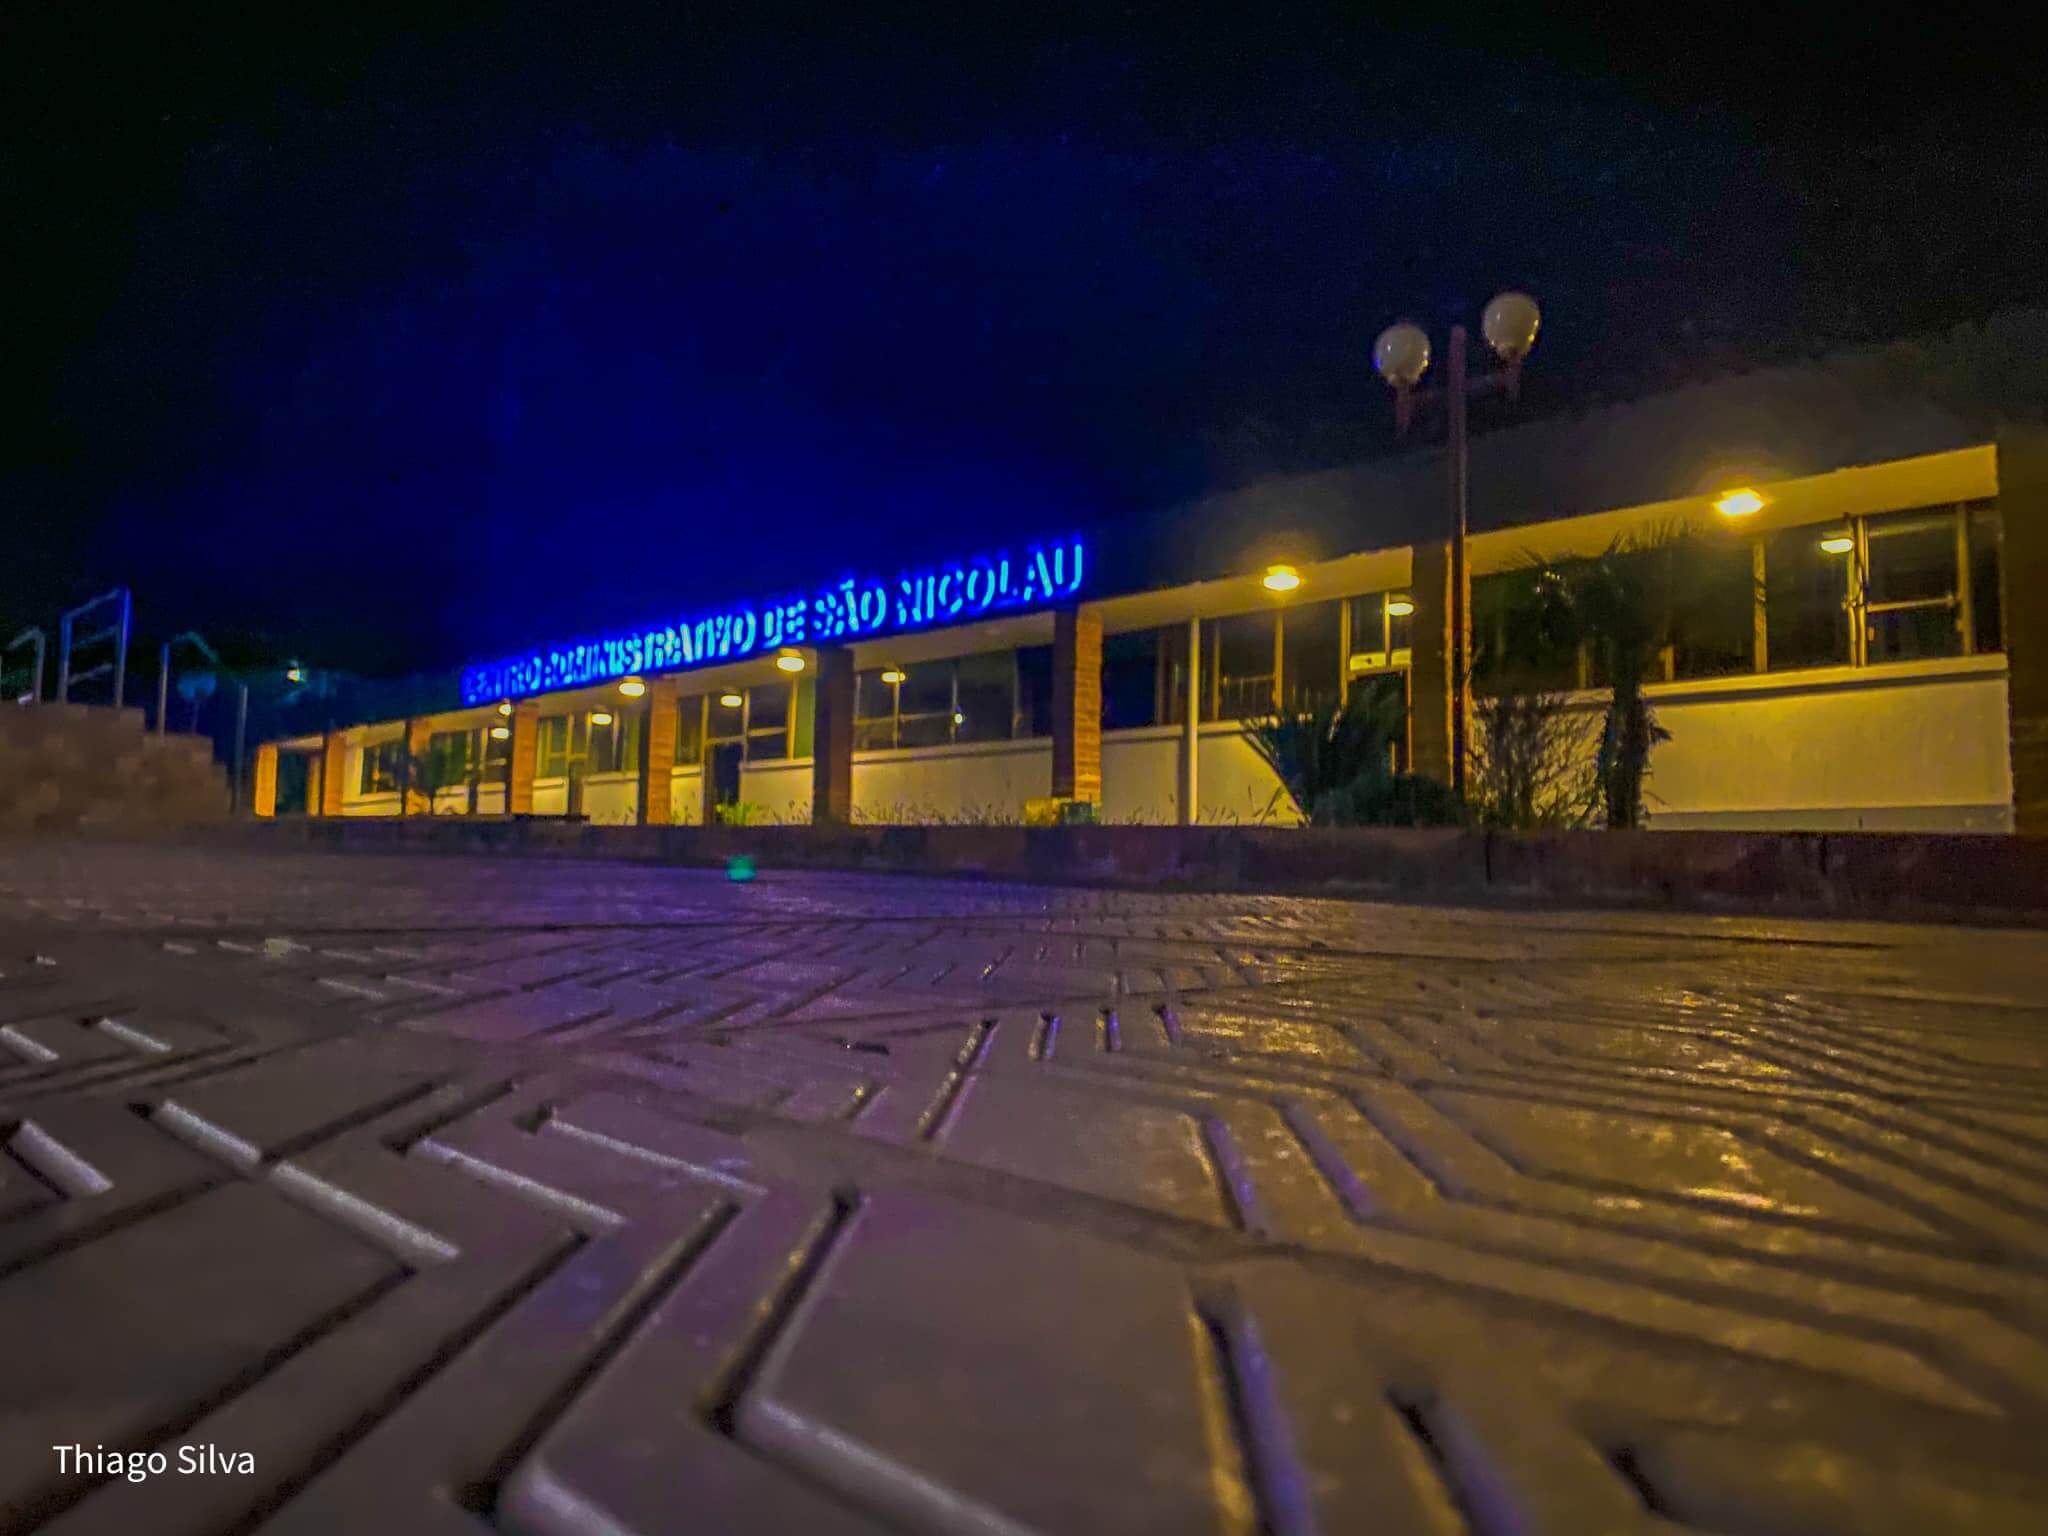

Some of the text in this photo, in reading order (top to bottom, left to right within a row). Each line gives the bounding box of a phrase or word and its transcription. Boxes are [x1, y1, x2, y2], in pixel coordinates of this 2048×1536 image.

[763, 600, 806, 647] DE
[815, 578, 887, 636] SÃO
[898, 543, 1082, 624] NICOLAU
